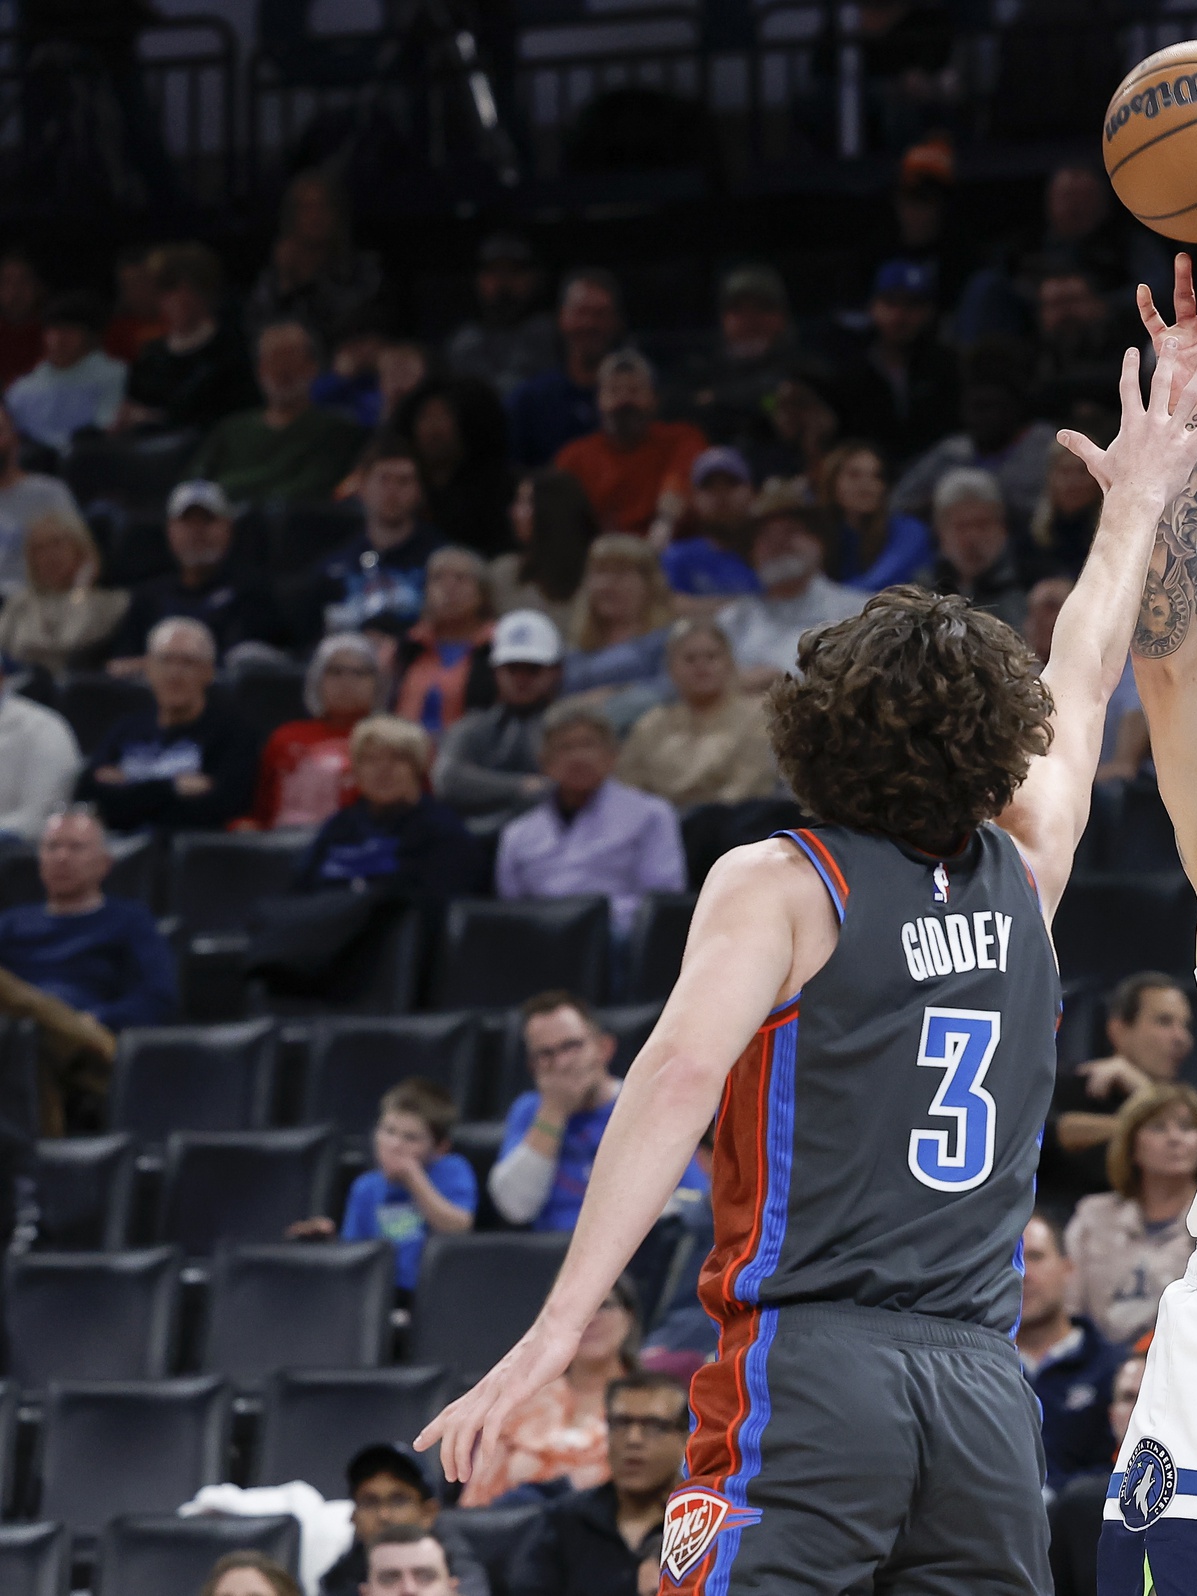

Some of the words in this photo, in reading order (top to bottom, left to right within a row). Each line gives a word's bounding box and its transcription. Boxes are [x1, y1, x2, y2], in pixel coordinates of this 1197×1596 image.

[901, 910, 1013, 982] GIDDEY
[907, 1006, 1001, 1193] 3
[660, 1504, 709, 1568] OKC
